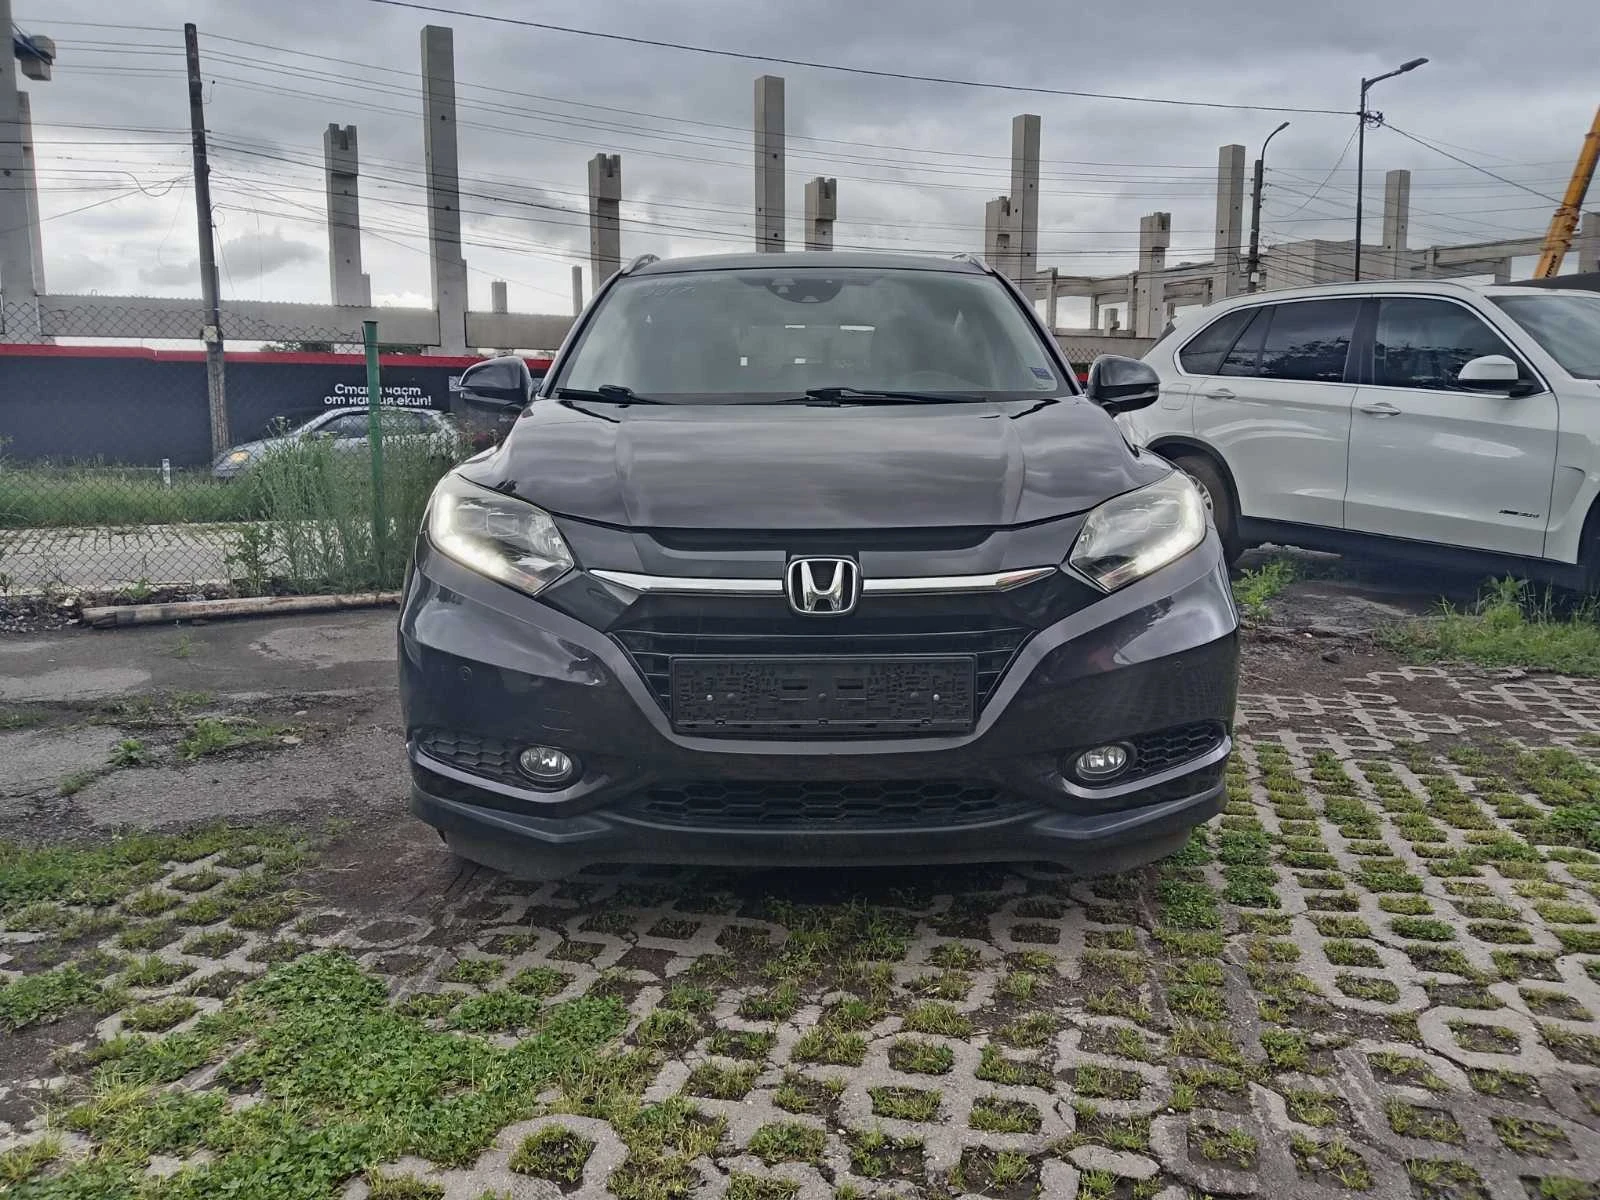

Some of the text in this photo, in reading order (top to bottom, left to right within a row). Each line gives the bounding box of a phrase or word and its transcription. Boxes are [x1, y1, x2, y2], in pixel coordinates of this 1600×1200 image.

[385, 385, 421, 396] част
[324, 394, 432, 406] от наия екип!
